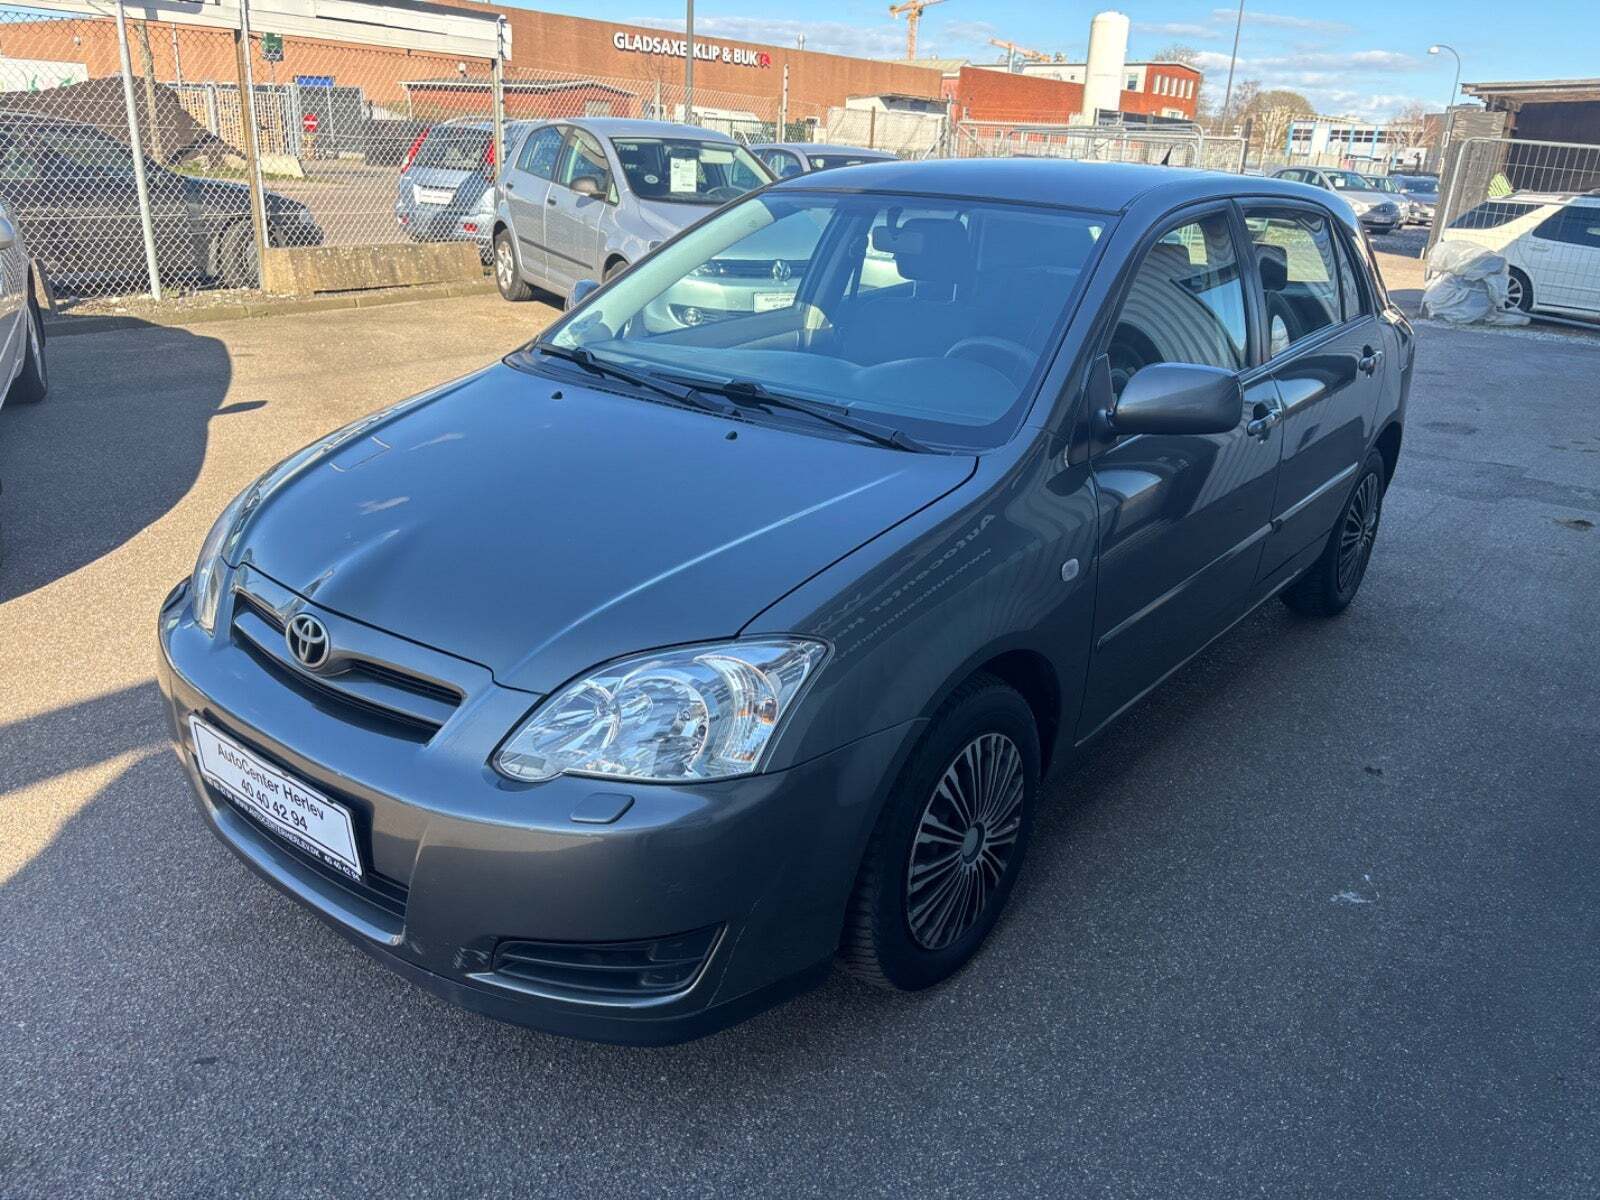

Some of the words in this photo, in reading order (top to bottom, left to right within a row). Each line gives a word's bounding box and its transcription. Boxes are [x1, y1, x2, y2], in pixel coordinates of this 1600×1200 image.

[613, 32, 687, 57] GLADSAXE
[693, 43, 720, 61] KLIP
[722, 47, 731, 62] &
[734, 48, 758, 65] BUK
[217, 743, 279, 794] AutoCenter
[282, 783, 324, 820] Herlev
[241, 779, 254, 797] 40
[257, 790, 270, 809] 40
[273, 801, 289, 821] 42
[291, 810, 308, 831] 94
